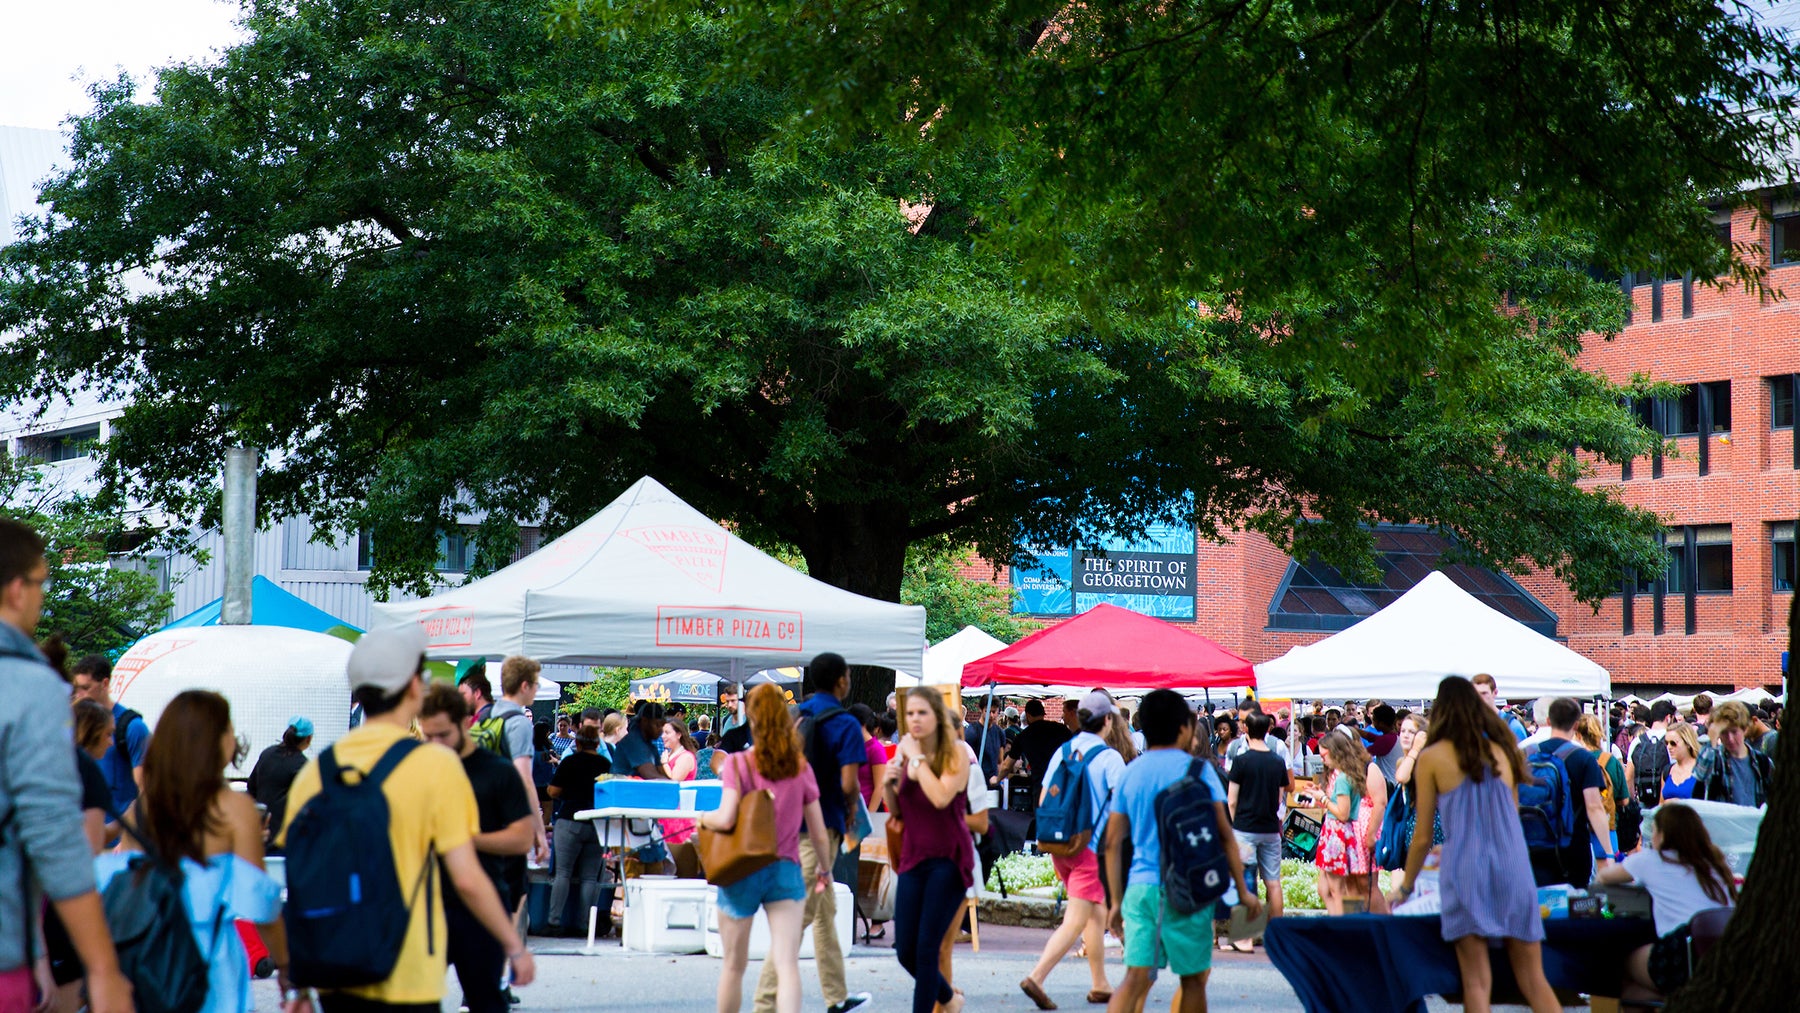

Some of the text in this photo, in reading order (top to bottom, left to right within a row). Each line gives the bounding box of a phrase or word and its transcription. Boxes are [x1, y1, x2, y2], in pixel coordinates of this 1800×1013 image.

[641, 529, 719, 547] TIMBER
[1085, 558, 1187, 575] THE SPIRIT OF
[1082, 572, 1187, 590] GEORGETOWN
[664, 617, 725, 637] TIMBER
[732, 618, 772, 639] PIZZA
